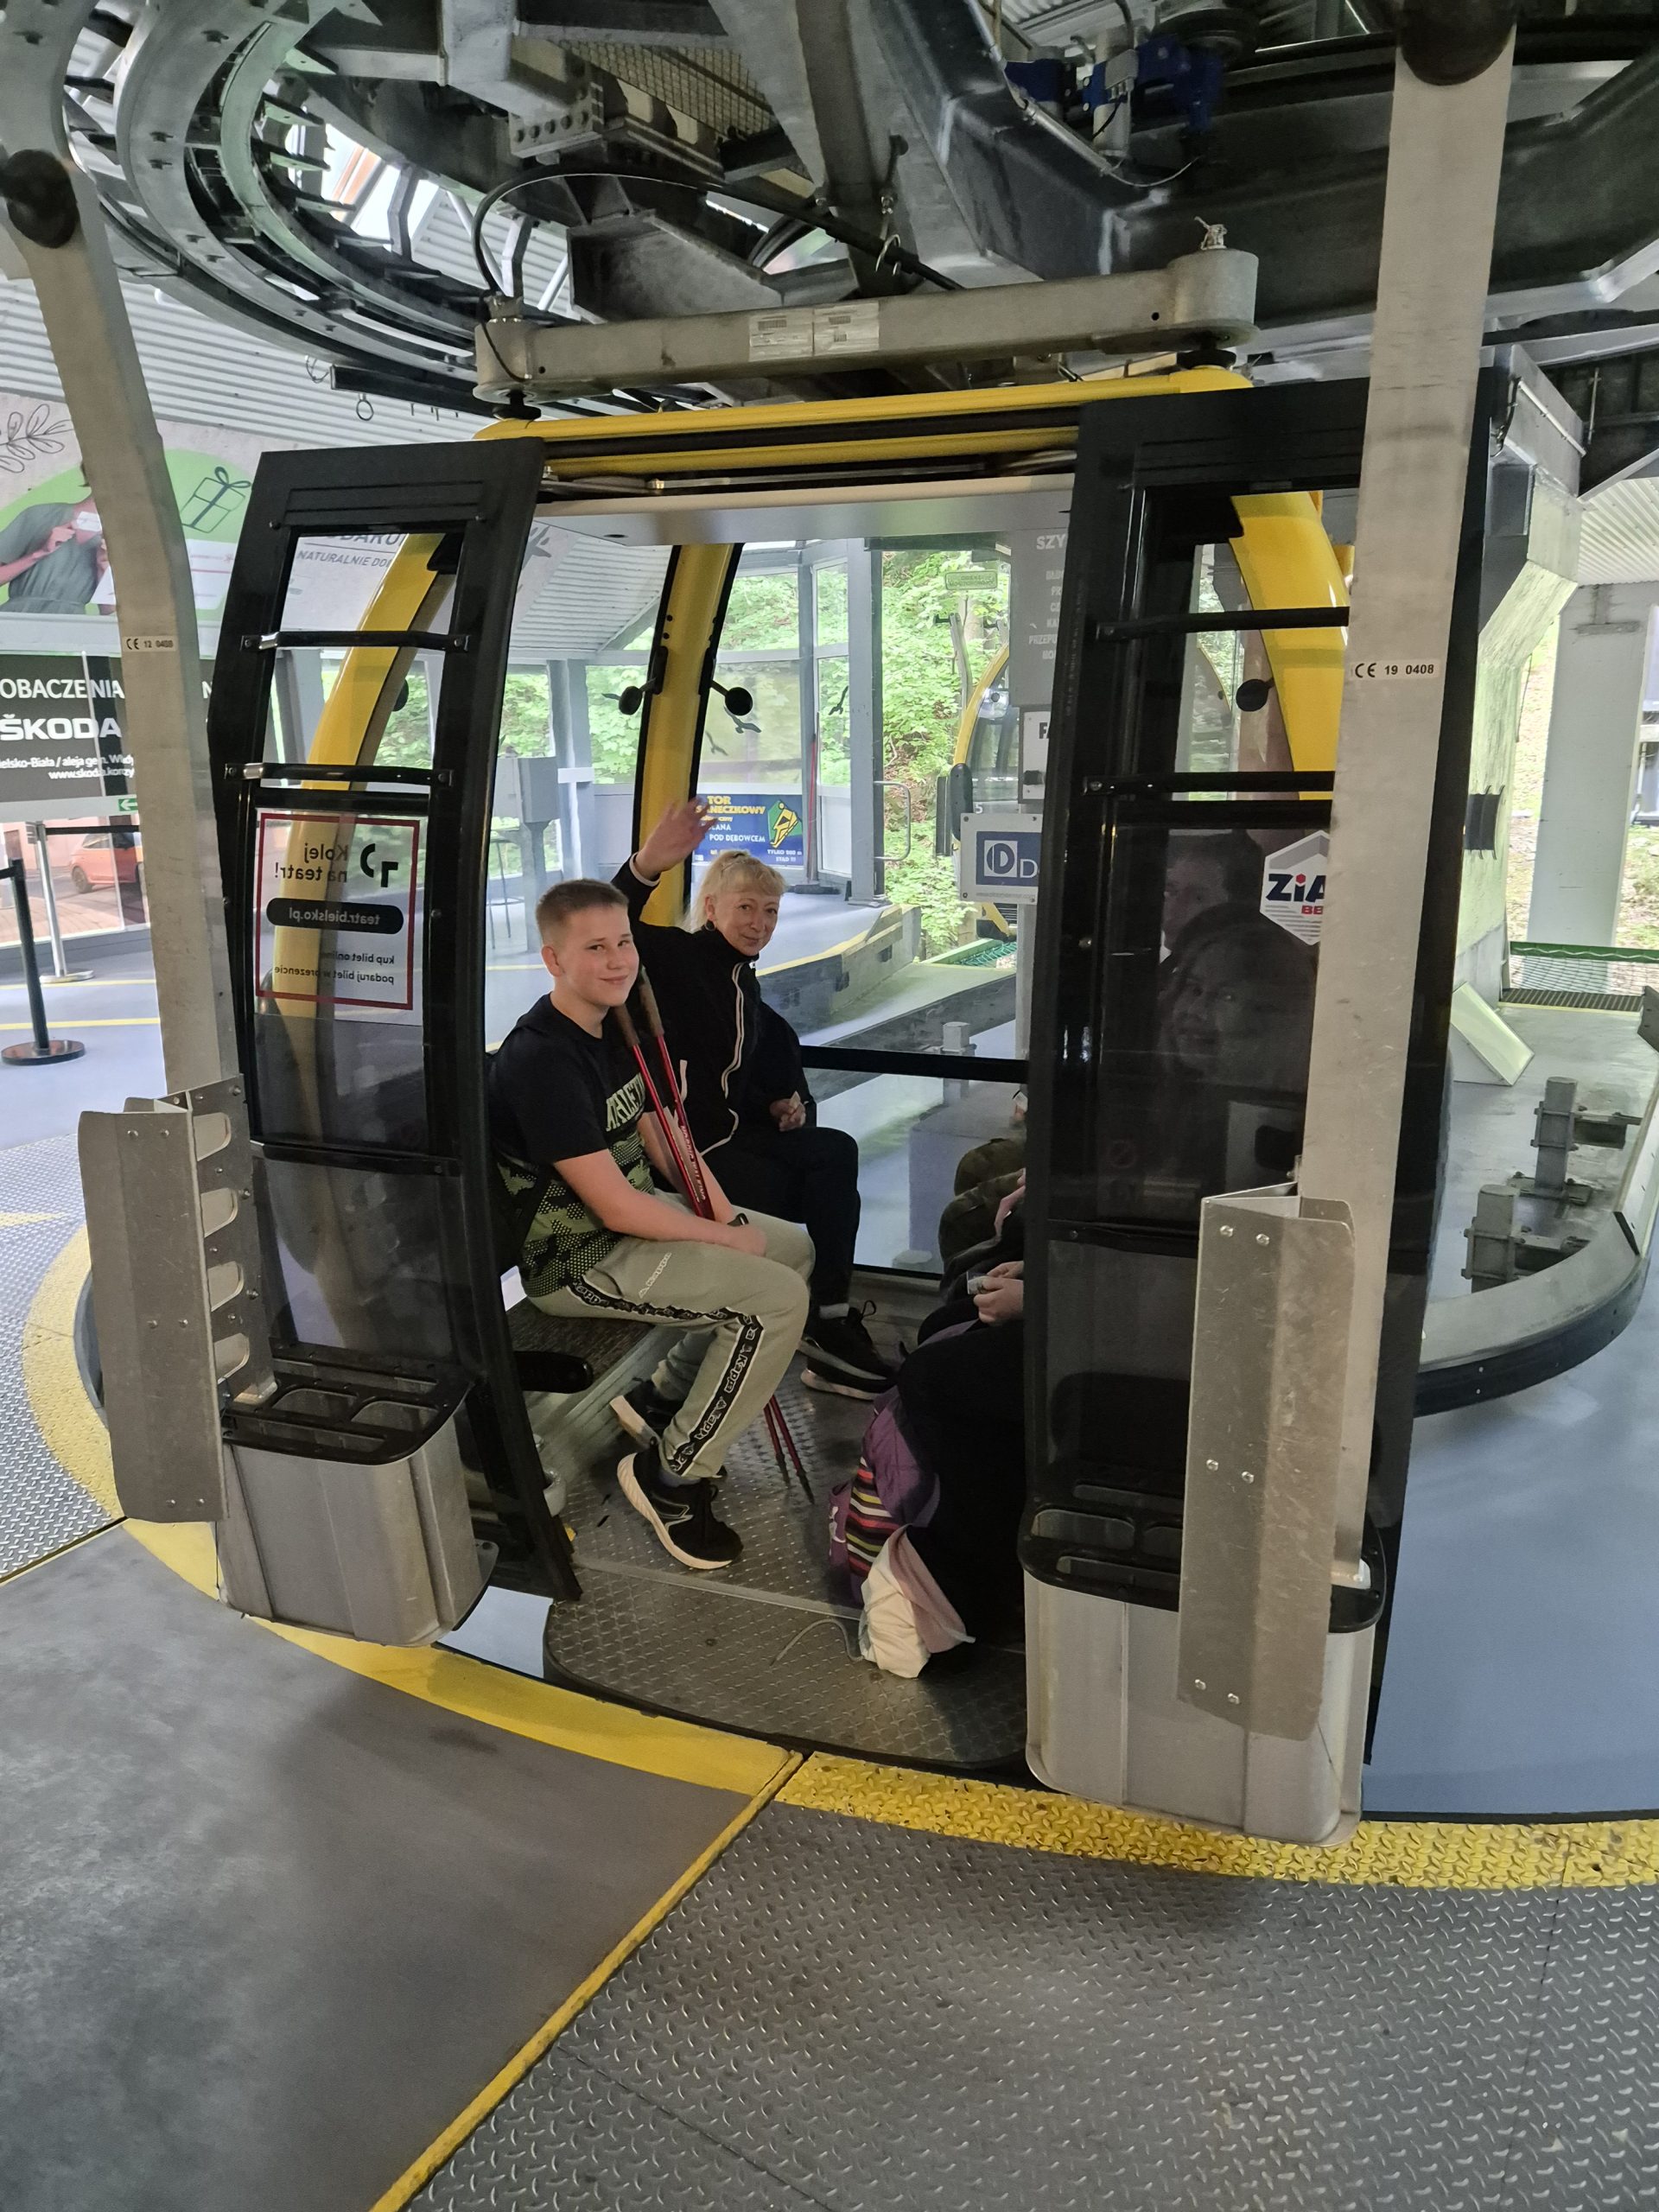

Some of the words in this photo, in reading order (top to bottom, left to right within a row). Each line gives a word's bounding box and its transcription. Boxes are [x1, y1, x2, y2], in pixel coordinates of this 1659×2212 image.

[297, 550, 370, 567] NATURALNIE
[1384, 664, 1398, 675] 19
[1405, 664, 1434, 674] 0408
[0, 713, 122, 741] ŠKODA
[707, 796, 731, 805] TOR
[696, 804, 766, 815] SNECZKOWY
[724, 1355, 748, 1394] Kappa
